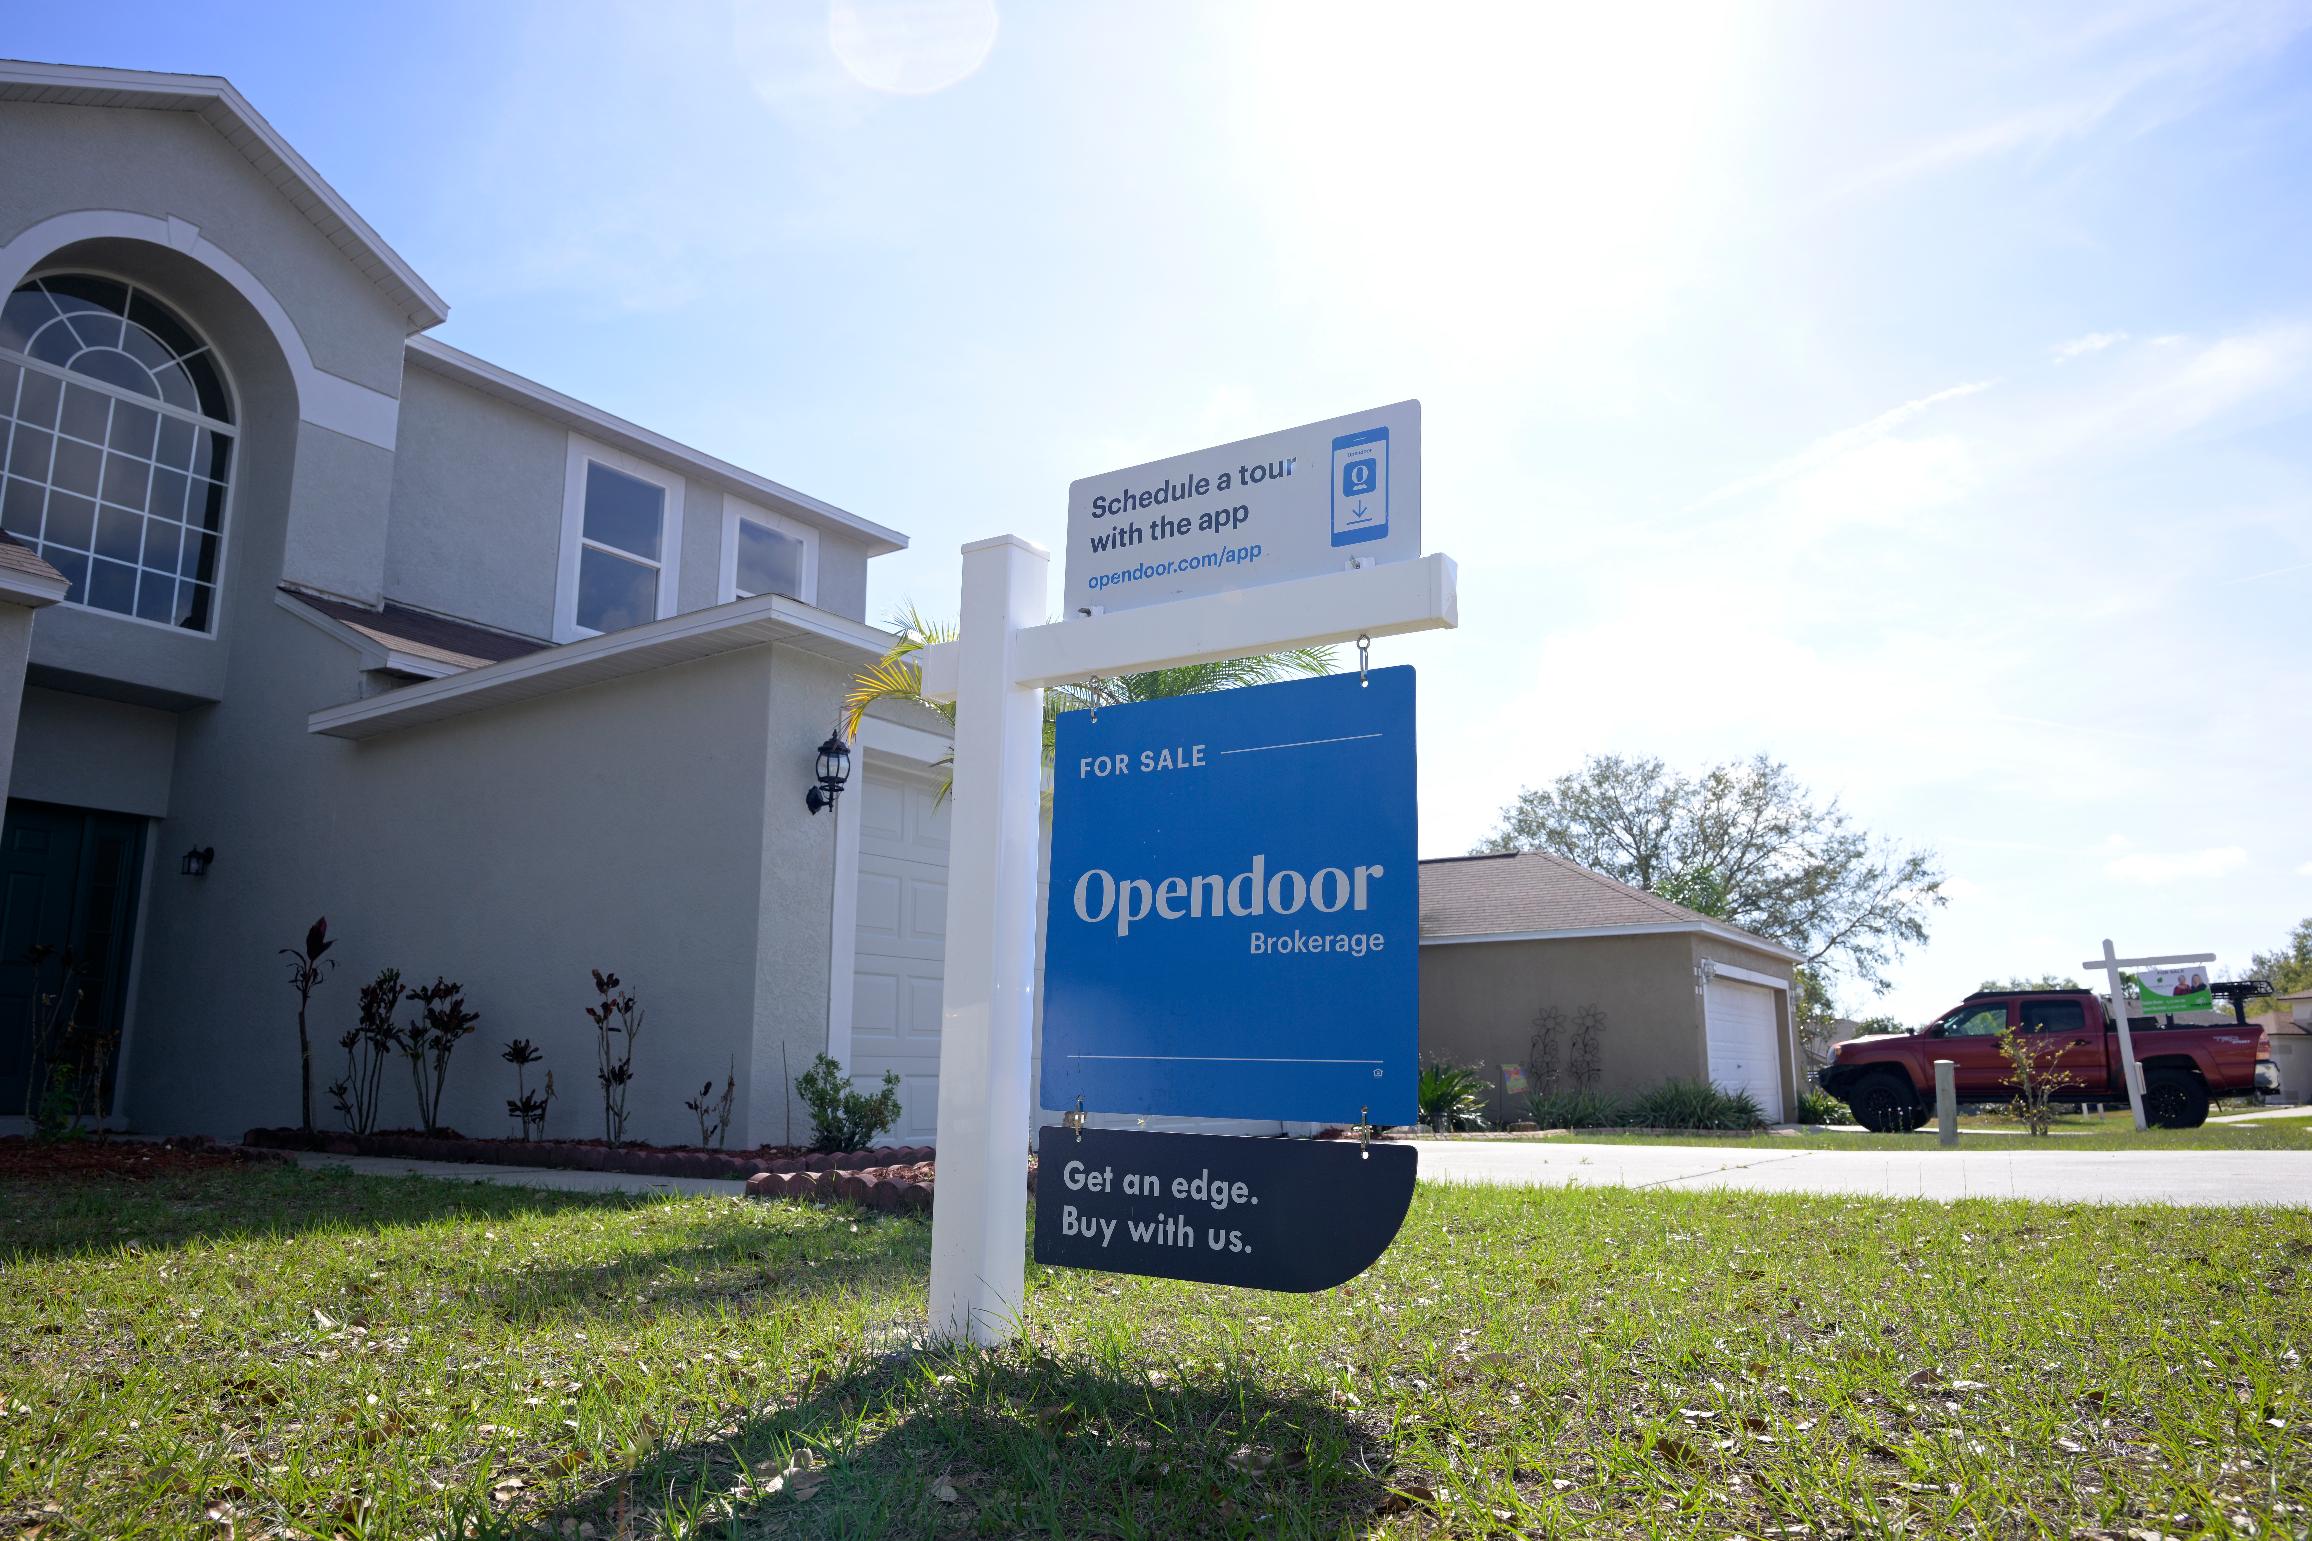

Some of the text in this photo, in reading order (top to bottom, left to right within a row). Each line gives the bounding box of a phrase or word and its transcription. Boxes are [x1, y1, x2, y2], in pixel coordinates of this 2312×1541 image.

[1091, 456, 1297, 519] Schedule a tour
[1090, 503, 1250, 554] with the app
[1088, 544, 1262, 592] opendoor.com/app
[1080, 744, 1206, 779] FOR SALE
[1073, 853, 1384, 937] Opendoor
[1250, 929, 1385, 957] Brokerage
[1063, 1159, 1259, 1210] Get an edge.
[1062, 1204, 1253, 1254] Buy with us.
